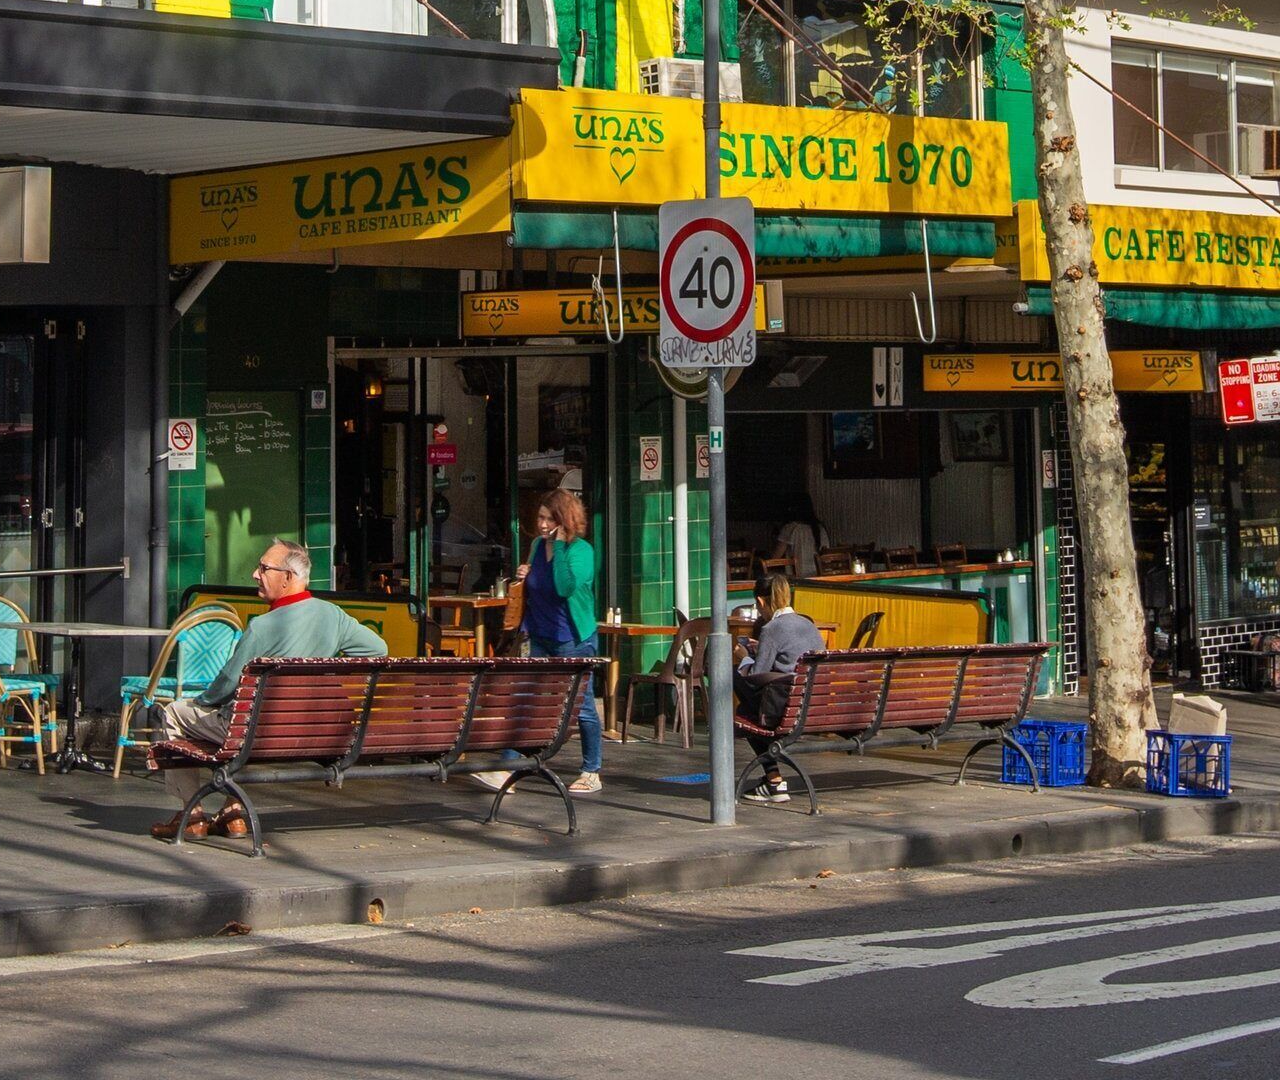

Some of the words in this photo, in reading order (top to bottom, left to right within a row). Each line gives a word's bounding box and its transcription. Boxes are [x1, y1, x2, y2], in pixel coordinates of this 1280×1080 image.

[573, 113, 665, 145] UNA'S
[719, 132, 858, 182] SINCE
[872, 142, 973, 188] 1970
[291, 155, 471, 220] UNA'S
[200, 185, 258, 208] UNA'S
[299, 221, 342, 239] CAFE
[349, 207, 462, 234] RESTAURANT
[200, 236, 230, 250] SINCE
[232, 234, 257, 247] 1970
[1103, 226, 1186, 262] CAFE
[678, 255, 735, 310] 40
[471, 297, 519, 313] UNA'S
[930, 358, 975, 370] UNA'S
[1143, 355, 1194, 369] UNA'S
[1227, 364, 1242, 376] NO
[1252, 363, 1280, 373] LOADING
[1222, 375, 1250, 386] STOPPING
[1257, 372, 1279, 383] ZONE
[710, 431, 722, 448] H
